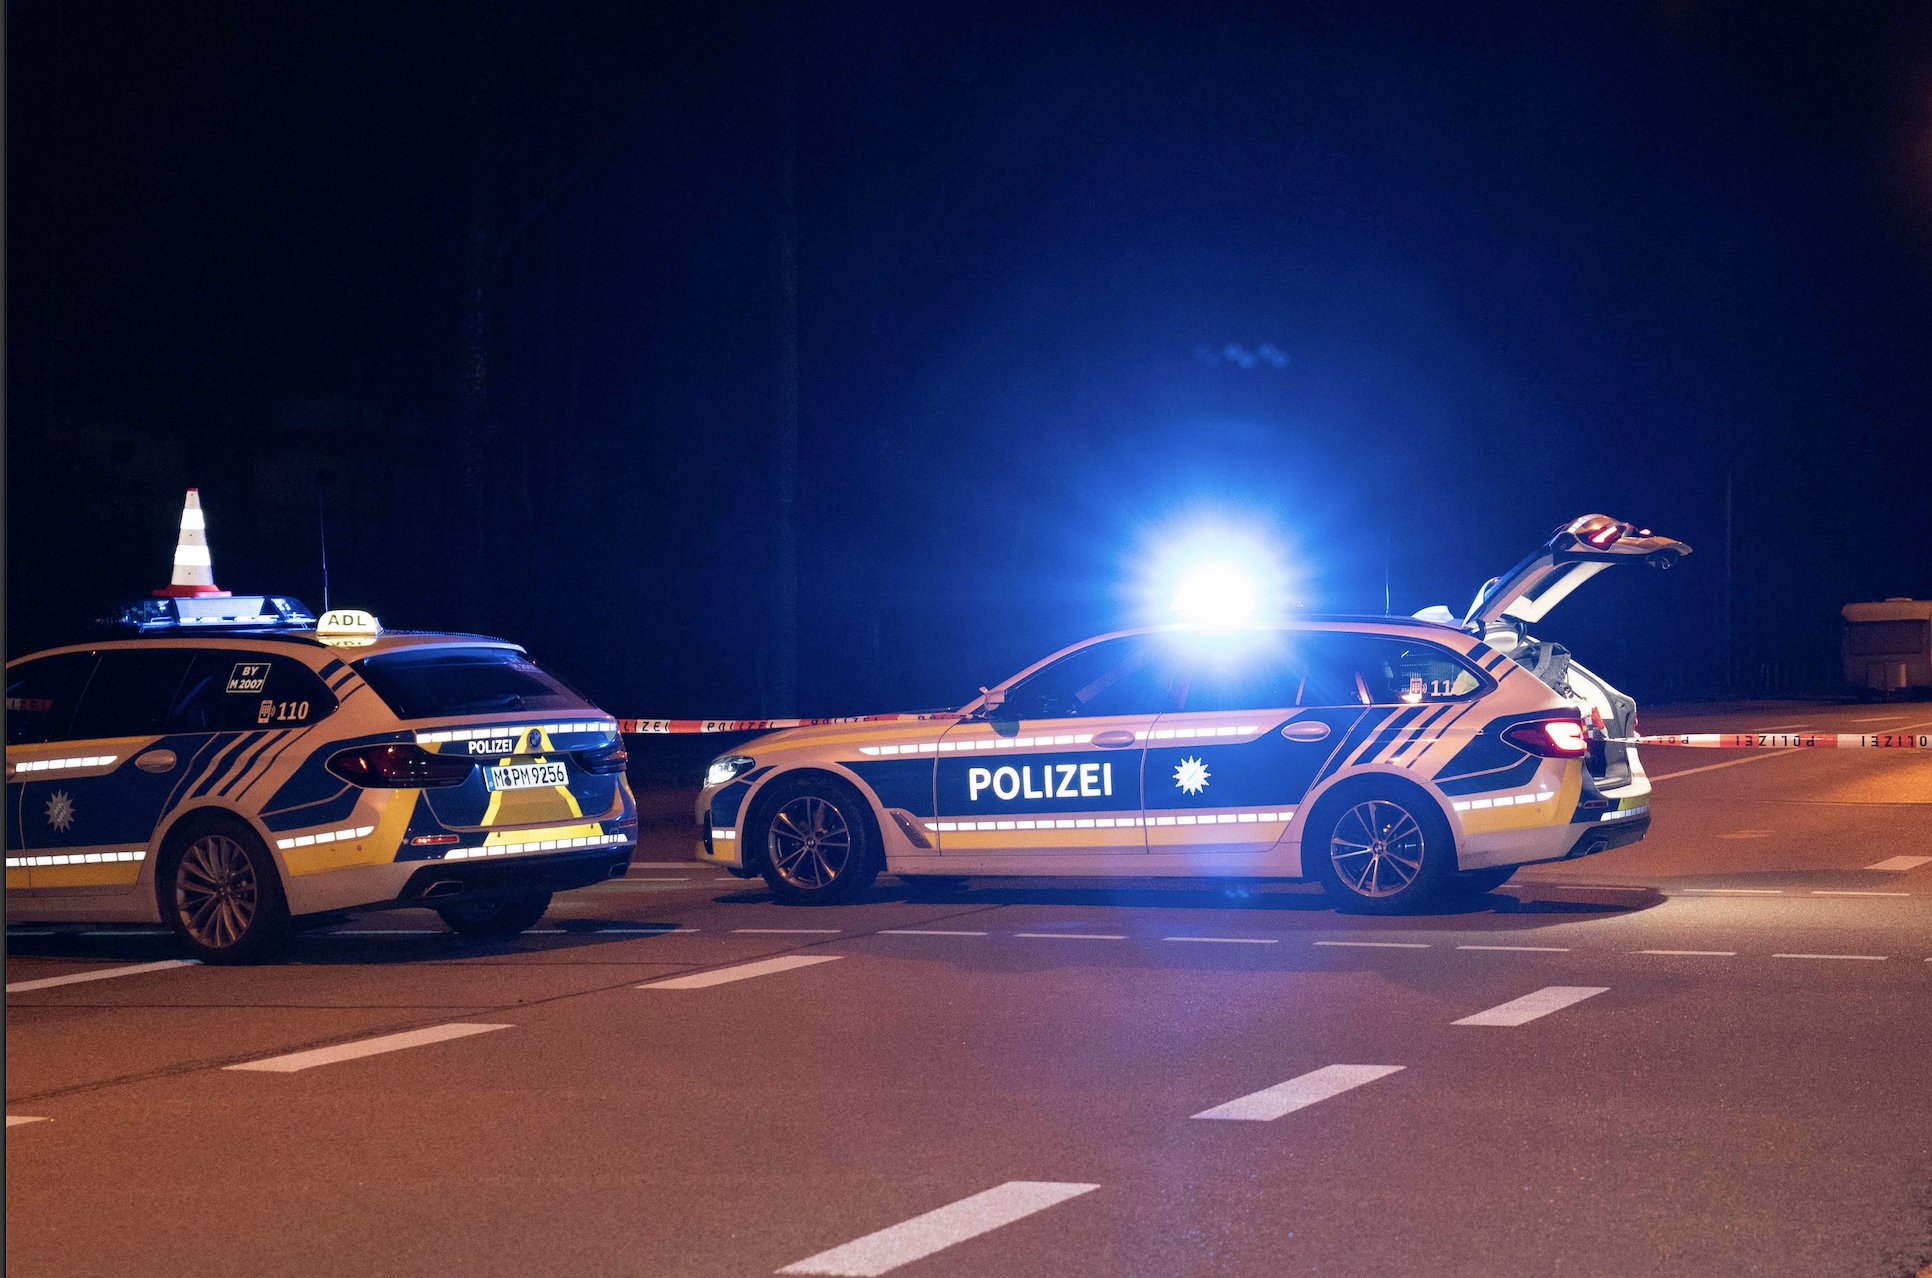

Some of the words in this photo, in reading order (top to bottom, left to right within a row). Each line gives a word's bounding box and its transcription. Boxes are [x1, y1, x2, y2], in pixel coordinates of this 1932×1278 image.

[328, 614, 367, 626] ADL
[242, 666, 259, 676] BY
[229, 679, 239, 689] M
[239, 679, 264, 689] 2007
[277, 701, 309, 720] 110
[618, 721, 669, 732] LIZEI
[468, 739, 513, 754] POLIZEI
[1736, 735, 1815, 747] POLIZEI
[531, 765, 565, 784] 9256
[969, 763, 1112, 801] POLIZEI
